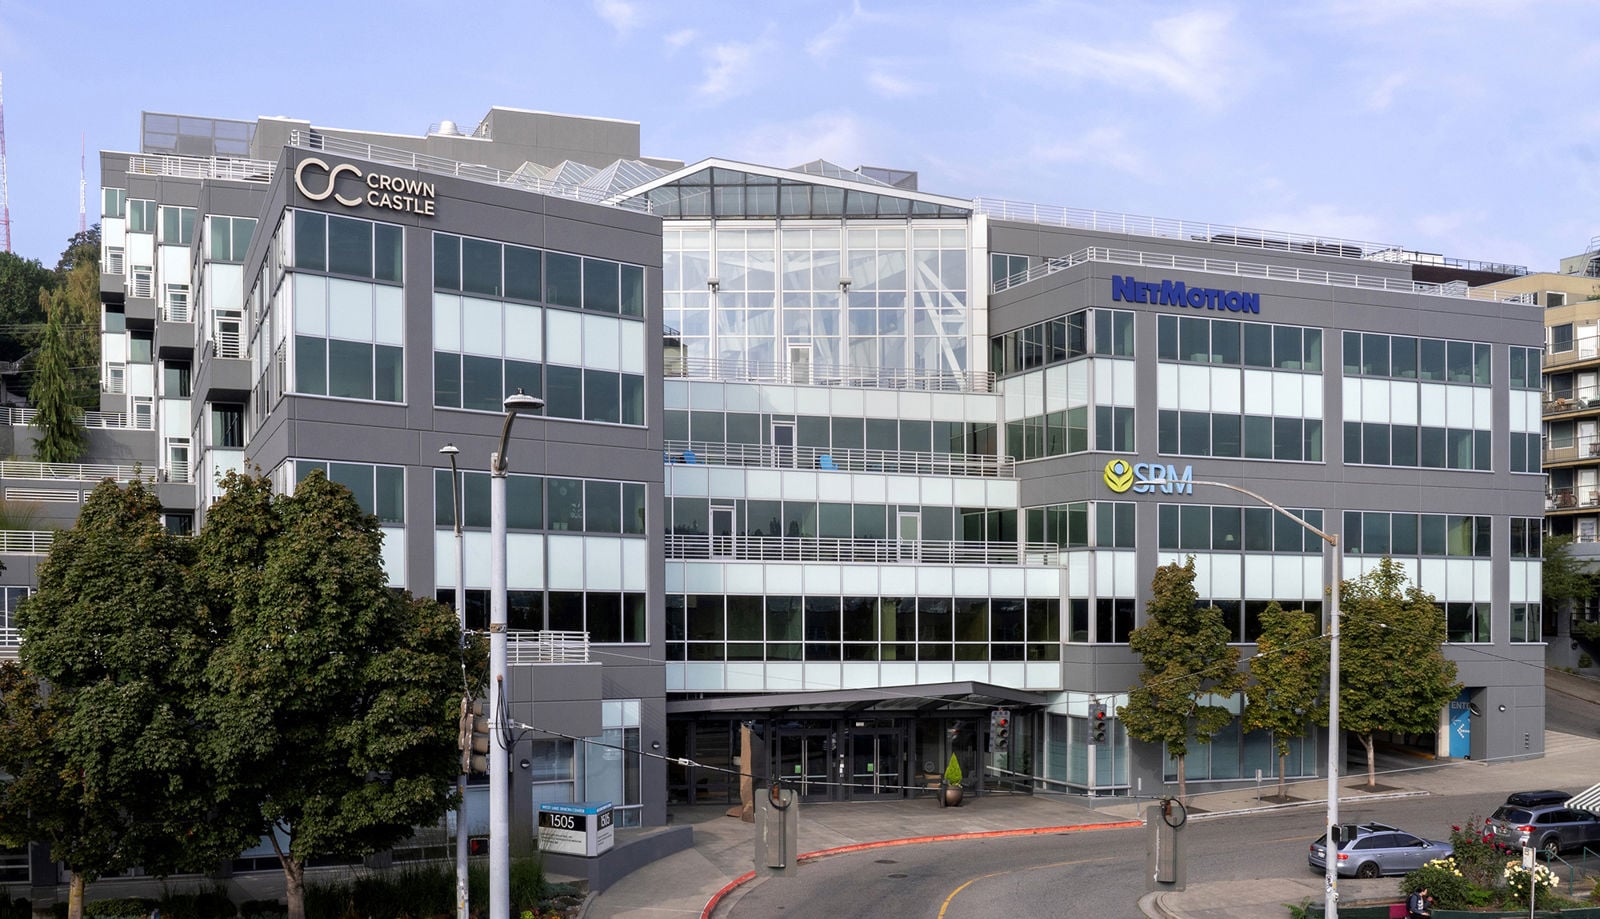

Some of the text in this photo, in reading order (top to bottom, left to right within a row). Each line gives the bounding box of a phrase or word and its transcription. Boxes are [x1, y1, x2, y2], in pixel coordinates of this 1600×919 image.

[366, 172, 435, 198] CROWN
[366, 190, 435, 215] CASTLE
[1133, 462, 1193, 495] SRM
[550, 814, 575, 829] 1505
